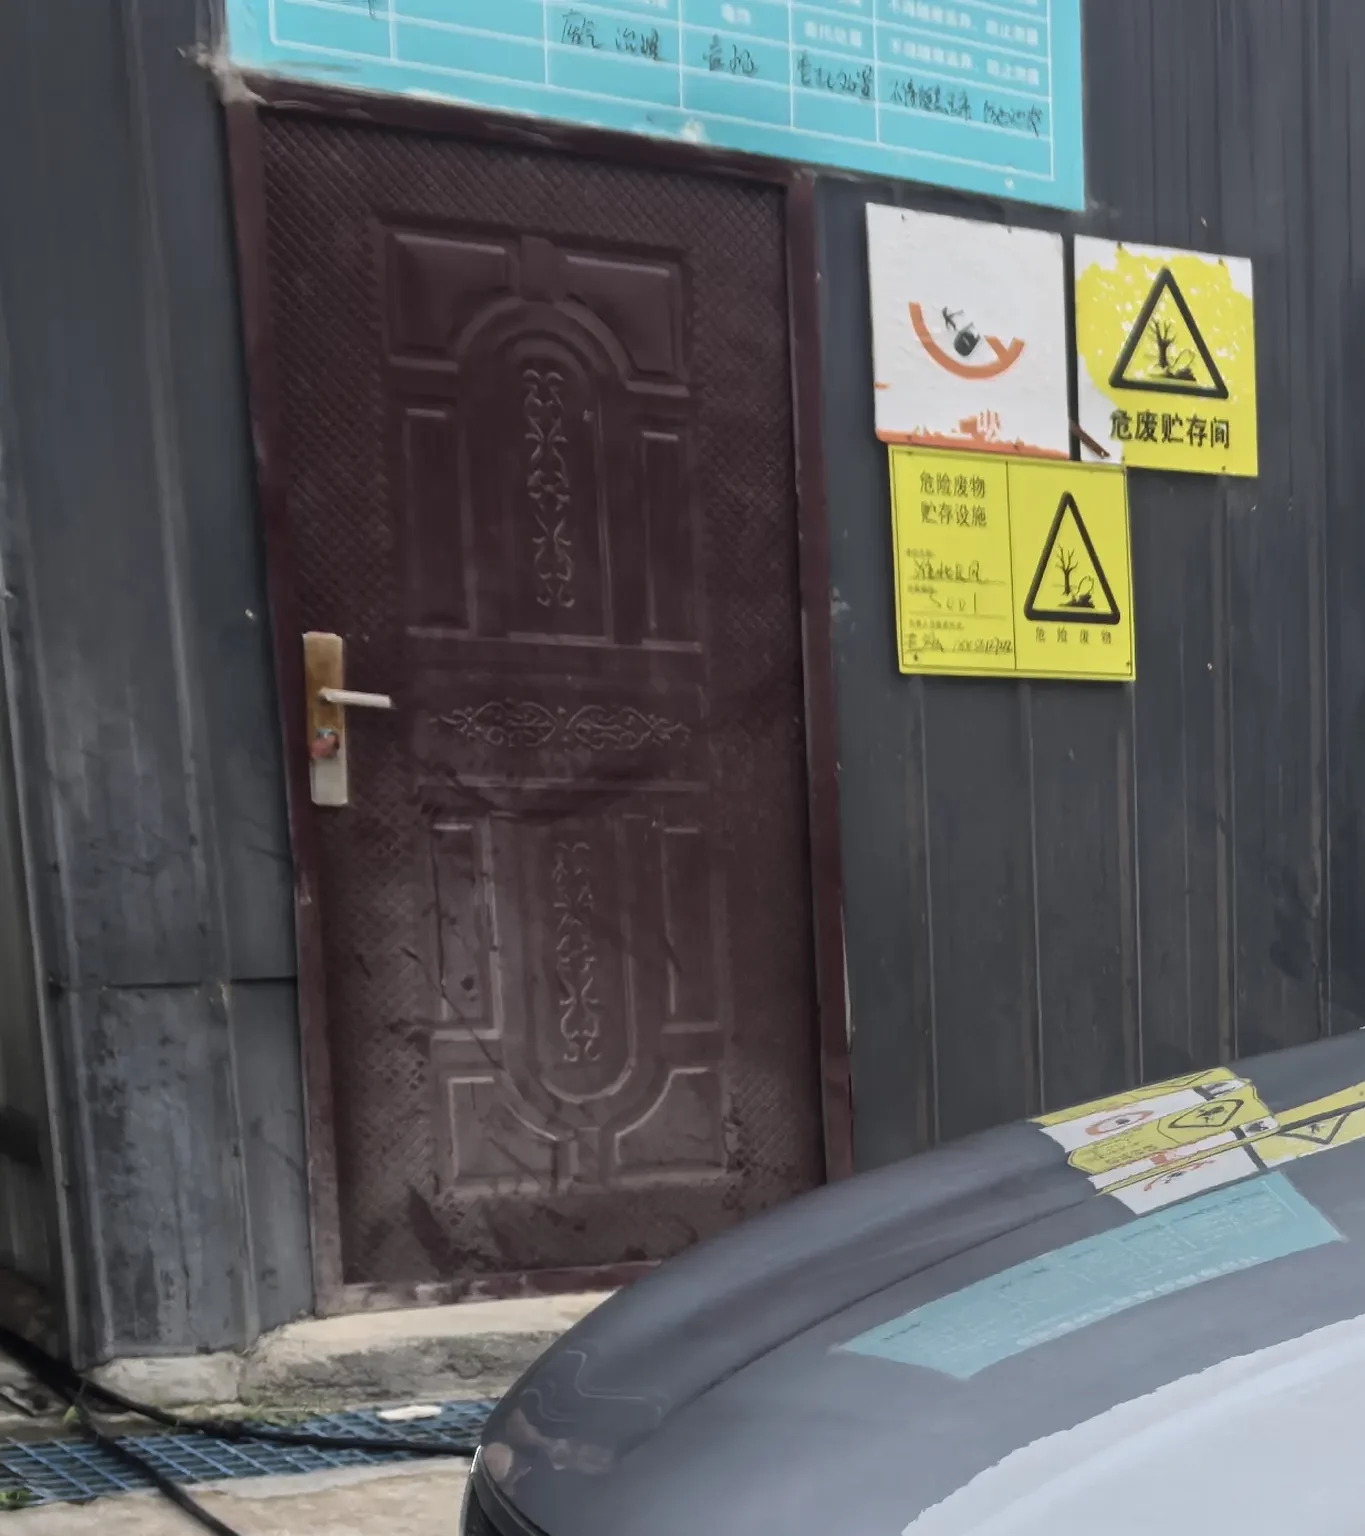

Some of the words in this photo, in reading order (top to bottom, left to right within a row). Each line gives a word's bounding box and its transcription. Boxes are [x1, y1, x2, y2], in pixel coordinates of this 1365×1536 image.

[1110, 408, 1230, 450] 危废贮存间
[920, 470, 986, 498] 危险废物
[921, 501, 987, 528] 贮存设施
[1035, 626, 1112, 645] 危险废物
